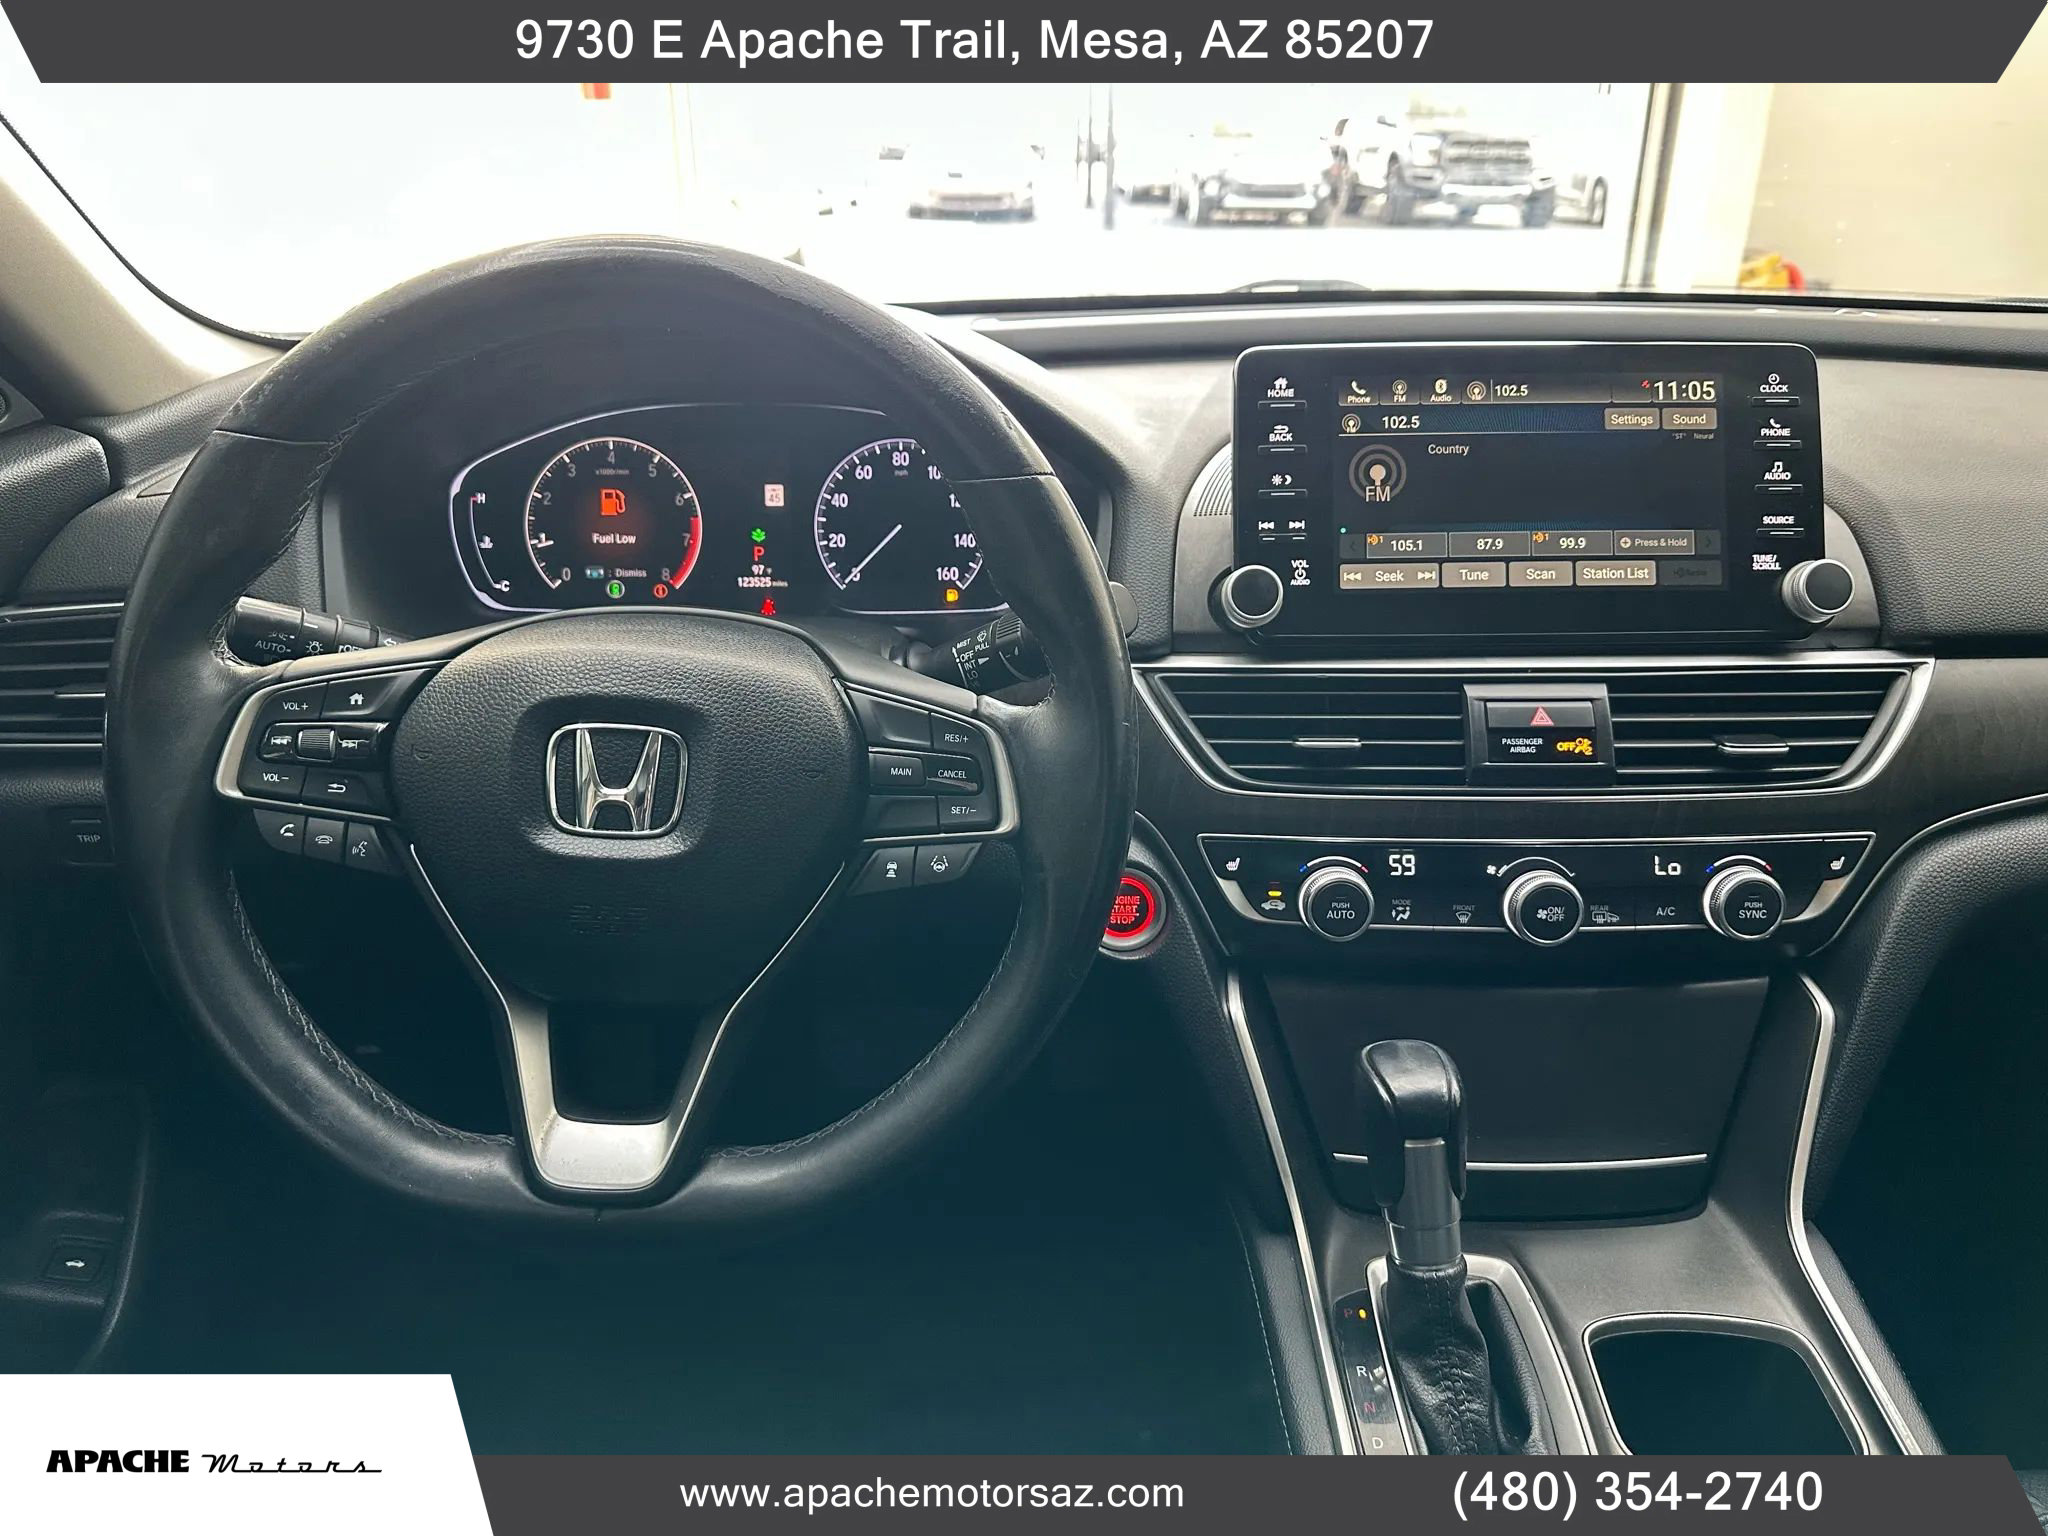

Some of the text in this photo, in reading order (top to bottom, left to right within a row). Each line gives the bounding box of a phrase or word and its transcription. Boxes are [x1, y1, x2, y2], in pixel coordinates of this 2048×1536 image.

[1268, 388, 1294, 398] HOME
[1494, 385, 1528, 397] 102.5
[1654, 380, 1715, 400] 11:05
[1760, 384, 1789, 393] CLOCK
[1347, 395, 1371, 404] Phone
[1430, 394, 1452, 402] Audio
[1382, 416, 1421, 429] 102.5
[1611, 413, 1653, 427] Settings
[1672, 413, 1706, 425] Sound
[1269, 433, 1293, 442] BACK
[1760, 428, 1791, 437] PHONE
[1428, 444, 1469, 456] Country
[607, 451, 616, 464] 4
[892, 451, 909, 466] 80
[567, 463, 577, 477] 3
[648, 463, 657, 477] 5
[855, 465, 872, 480] 60
[1763, 472, 1791, 480] AUDIO
[476, 492, 485, 504] H
[543, 492, 552, 505] 2
[675, 493, 684, 506] 6
[831, 493, 848, 507] 40
[1365, 486, 1391, 502] FM
[1763, 515, 1795, 524] SOURCE
[592, 533, 636, 544] Fuel Low
[682, 533, 691, 547] 7
[829, 533, 846, 548] 20
[954, 533, 976, 548] 140
[1476, 538, 1504, 550] 87.9
[1559, 537, 1586, 549] 99.9
[1635, 537, 1687, 547] Press & Hold
[1391, 540, 1423, 551] 105.1
[754, 546, 765, 561] P
[1752, 554, 1777, 563] TUNE/
[752, 564, 765, 575] 97
[1291, 560, 1309, 568] VOL
[1752, 562, 1781, 570] SCROLL
[561, 568, 571, 580] 0
[615, 568, 647, 578] Dismiss
[662, 568, 671, 581] 8
[936, 567, 959, 581] 160
[1375, 570, 1404, 582] Seek
[1459, 569, 1489, 581] Tune
[1526, 568, 1556, 580] Scan
[1583, 566, 1649, 580] Station List
[500, 580, 510, 592] C
[737, 576, 771, 587] 123525
[255, 640, 286, 653] AUTO
[956, 638, 971, 649] MIST
[975, 641, 990, 652] PULL
[960, 650, 974, 662] OFF
[964, 660, 976, 671] INT
[944, 733, 969, 743] RES/+
[1556, 742, 1576, 751] OFF
[890, 767, 912, 777] MAIN
[938, 769, 967, 780] CANCEL
[77, 834, 101, 843] TRIP
[1388, 854, 1415, 876] 59
[1654, 855, 1681, 876] Lo
[1326, 910, 1355, 920] AUTO
[1547, 906, 1565, 915] ON/
[1656, 906, 1676, 916] A/C
[1738, 909, 1768, 919] SYNC
[1110, 916, 1135, 924] STOP
[1547, 913, 1565, 922] OFF
[1356, 1366, 1368, 1377] R
[1364, 1402, 1376, 1413] N
[1372, 1437, 1384, 1449] D
